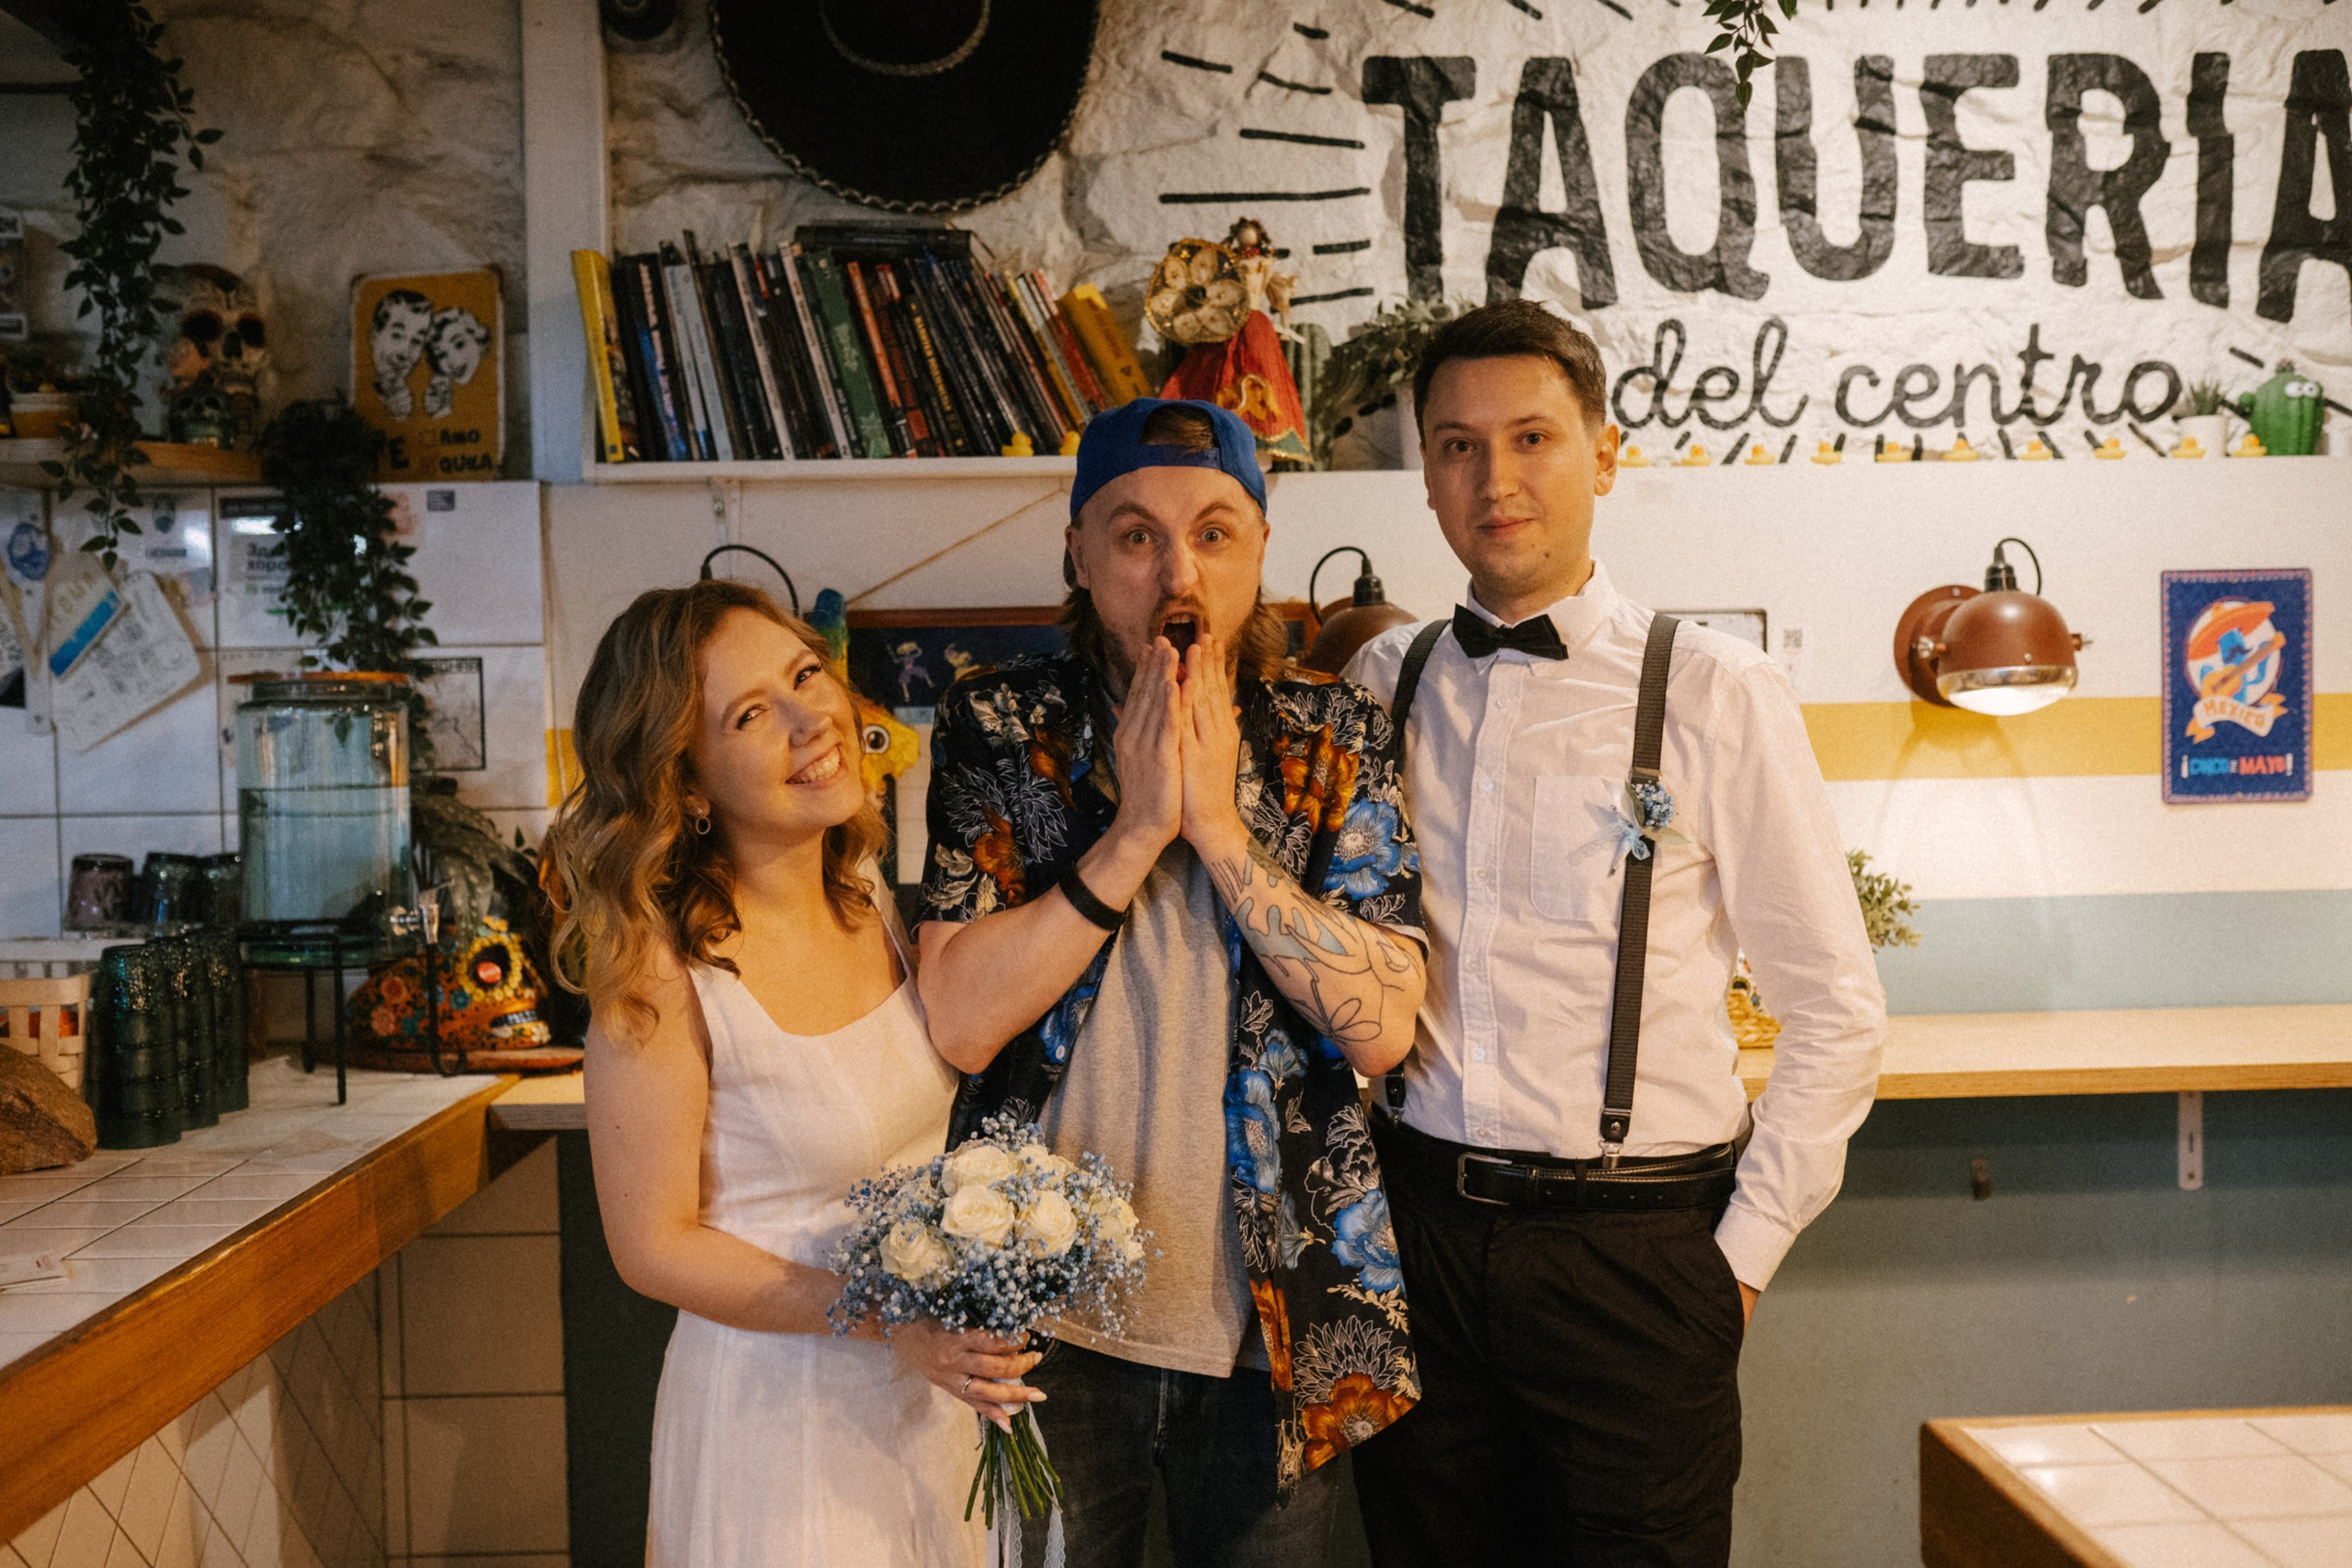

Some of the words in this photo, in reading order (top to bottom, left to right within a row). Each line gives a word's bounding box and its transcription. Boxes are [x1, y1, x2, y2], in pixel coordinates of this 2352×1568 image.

[1362, 50, 2352, 323] TAQUERIA
[1611, 318, 1809, 431] del
[1835, 322, 2182, 428] centro
[2204, 699, 2266, 728] MEXICO
